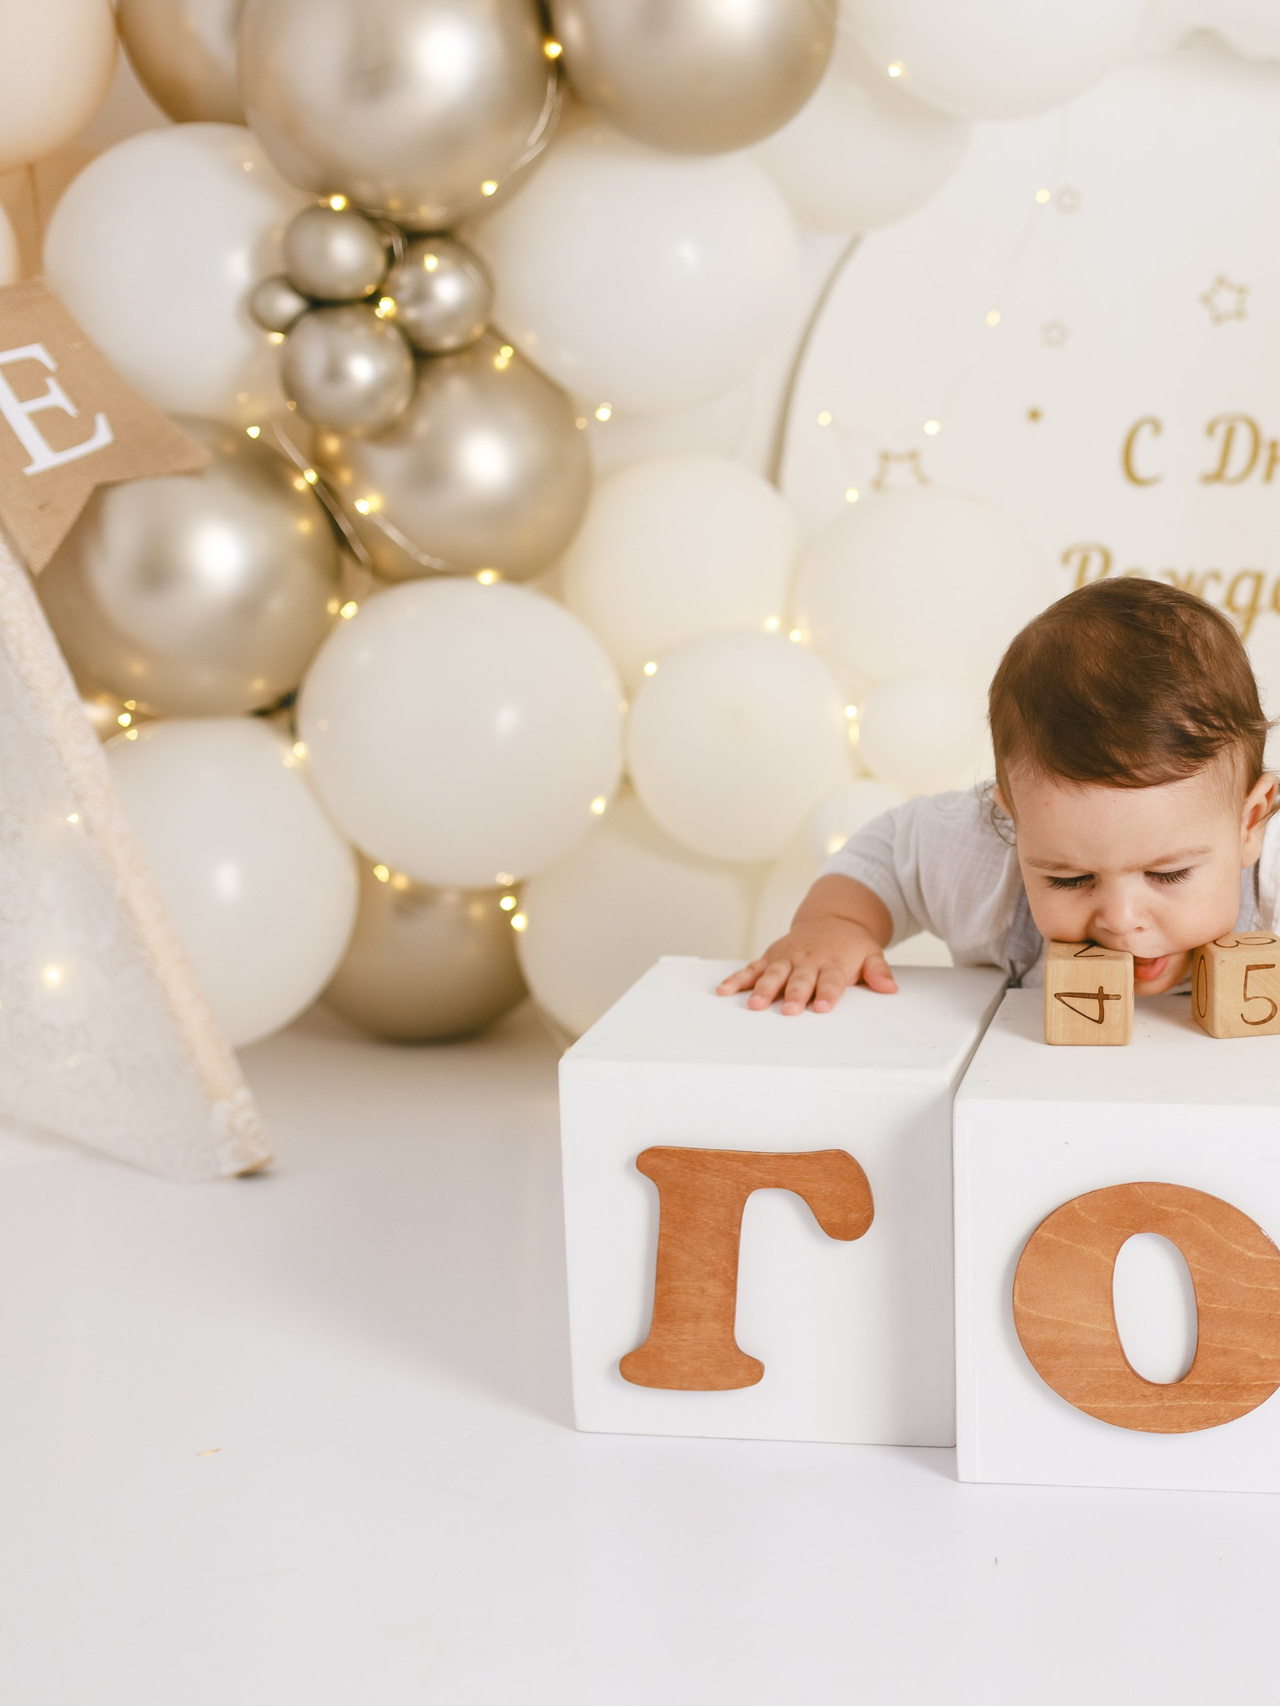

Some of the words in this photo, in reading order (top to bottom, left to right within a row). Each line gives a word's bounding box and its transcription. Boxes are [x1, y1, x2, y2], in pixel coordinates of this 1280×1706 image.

[1121, 415, 1164, 487] С
[1053, 985, 1122, 1025] 4
[1240, 963, 1278, 1026] 5
